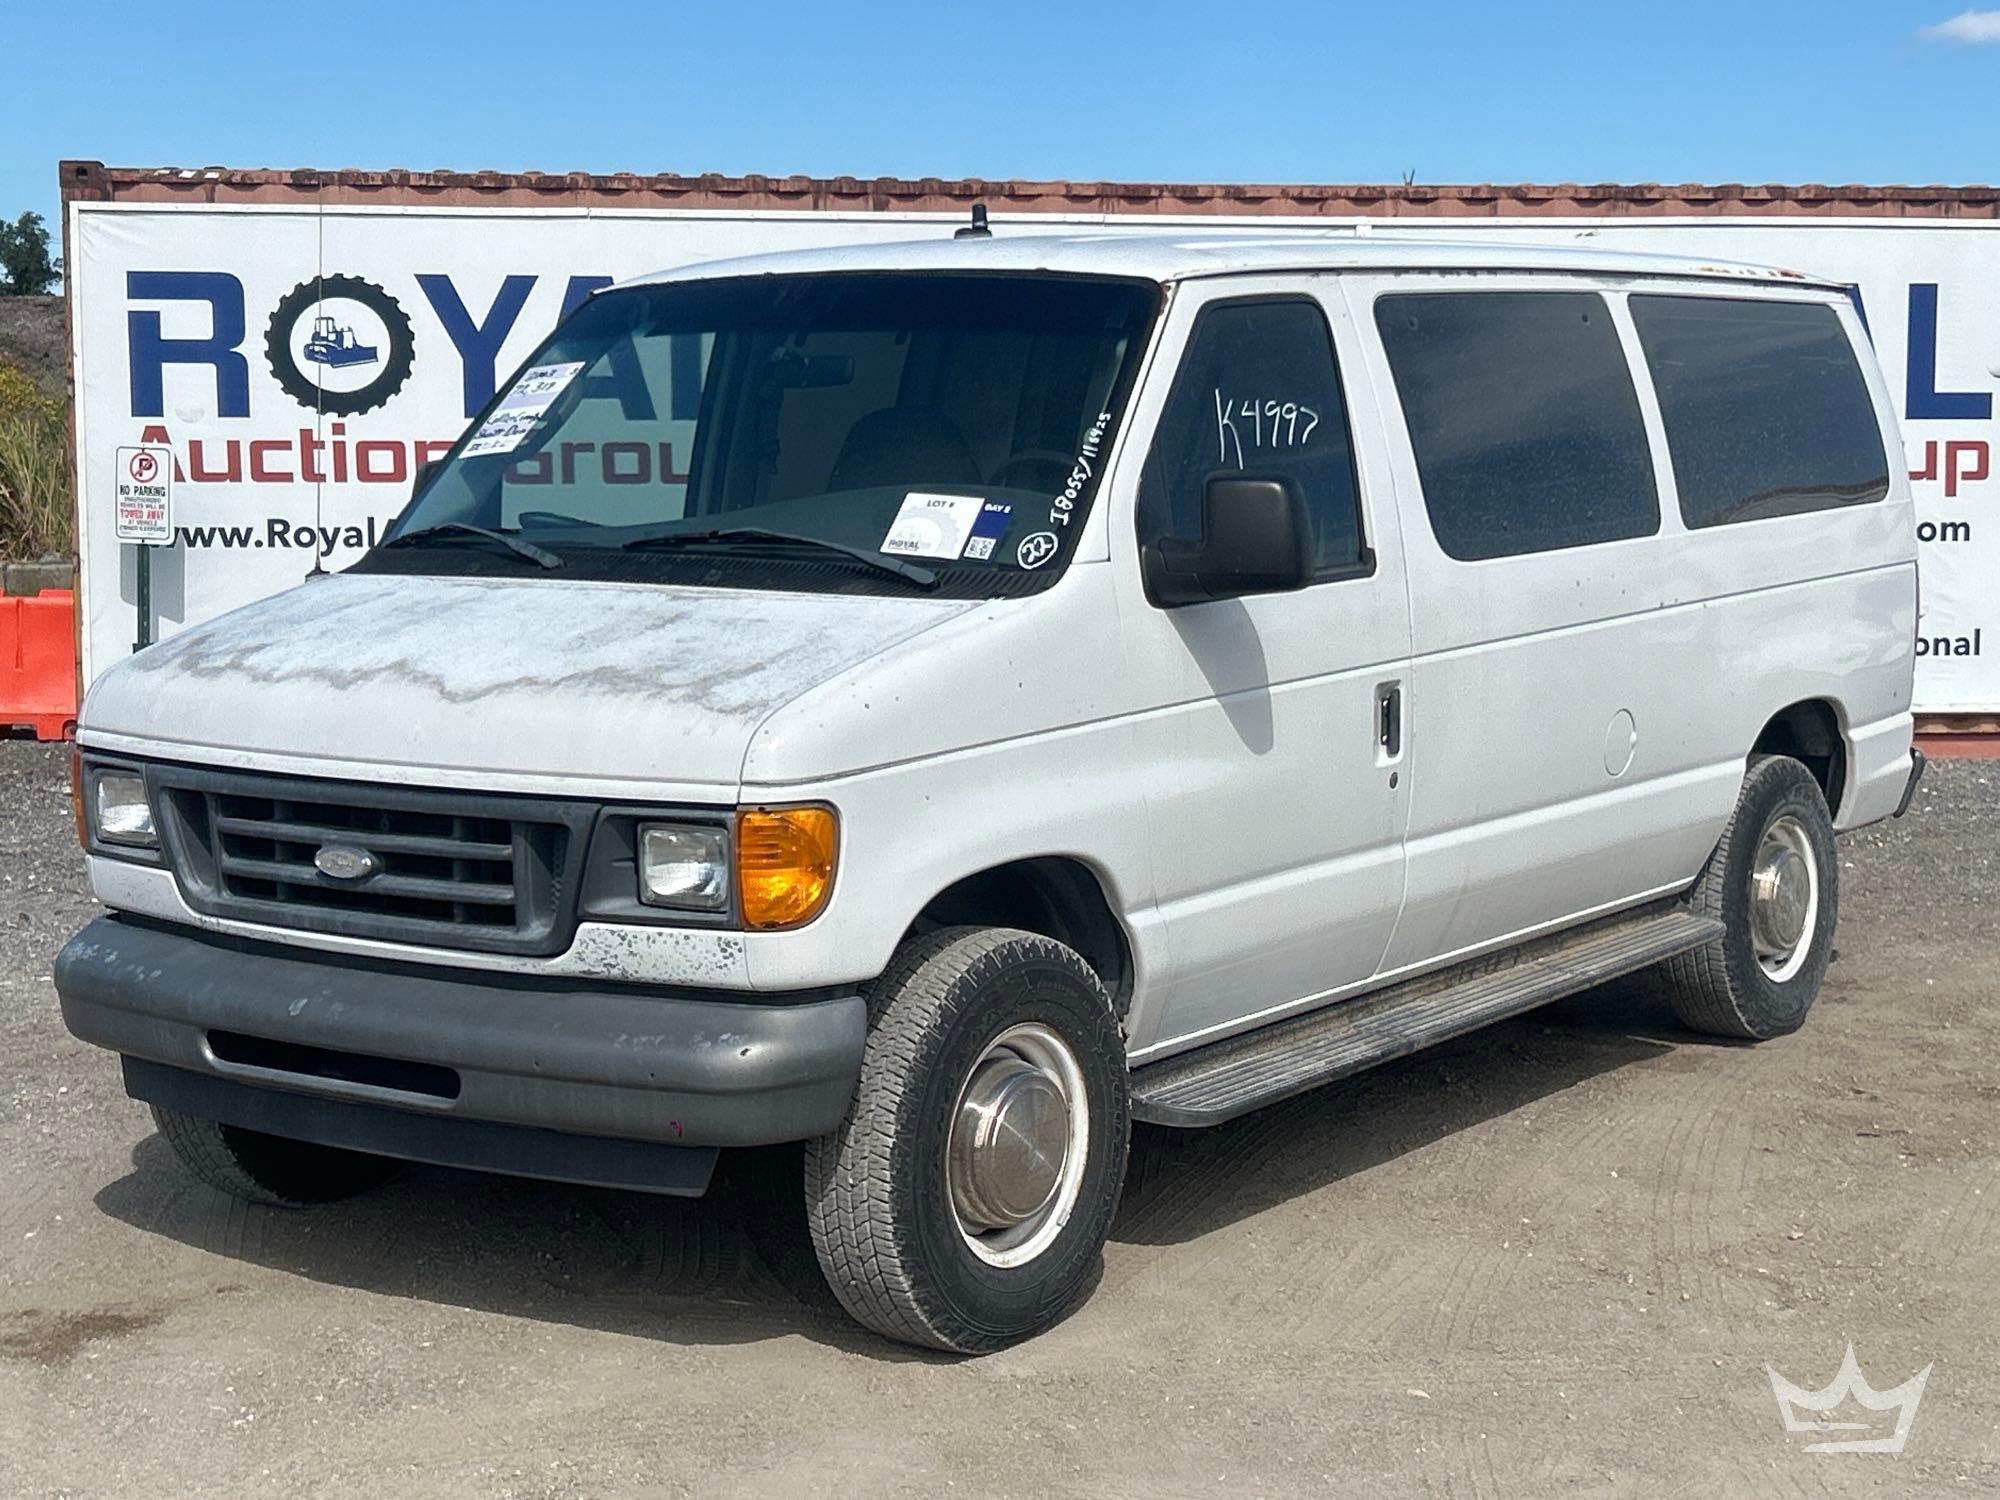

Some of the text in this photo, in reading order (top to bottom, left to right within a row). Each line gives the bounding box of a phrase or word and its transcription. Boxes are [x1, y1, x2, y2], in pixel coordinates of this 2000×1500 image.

[1856, 283, 1993, 420] L
[1214, 387, 1319, 470] K4997
[926, 499, 947, 508] LOT
[150, 516, 376, 557] ww.Royal
[1022, 536, 1053, 563] 22
